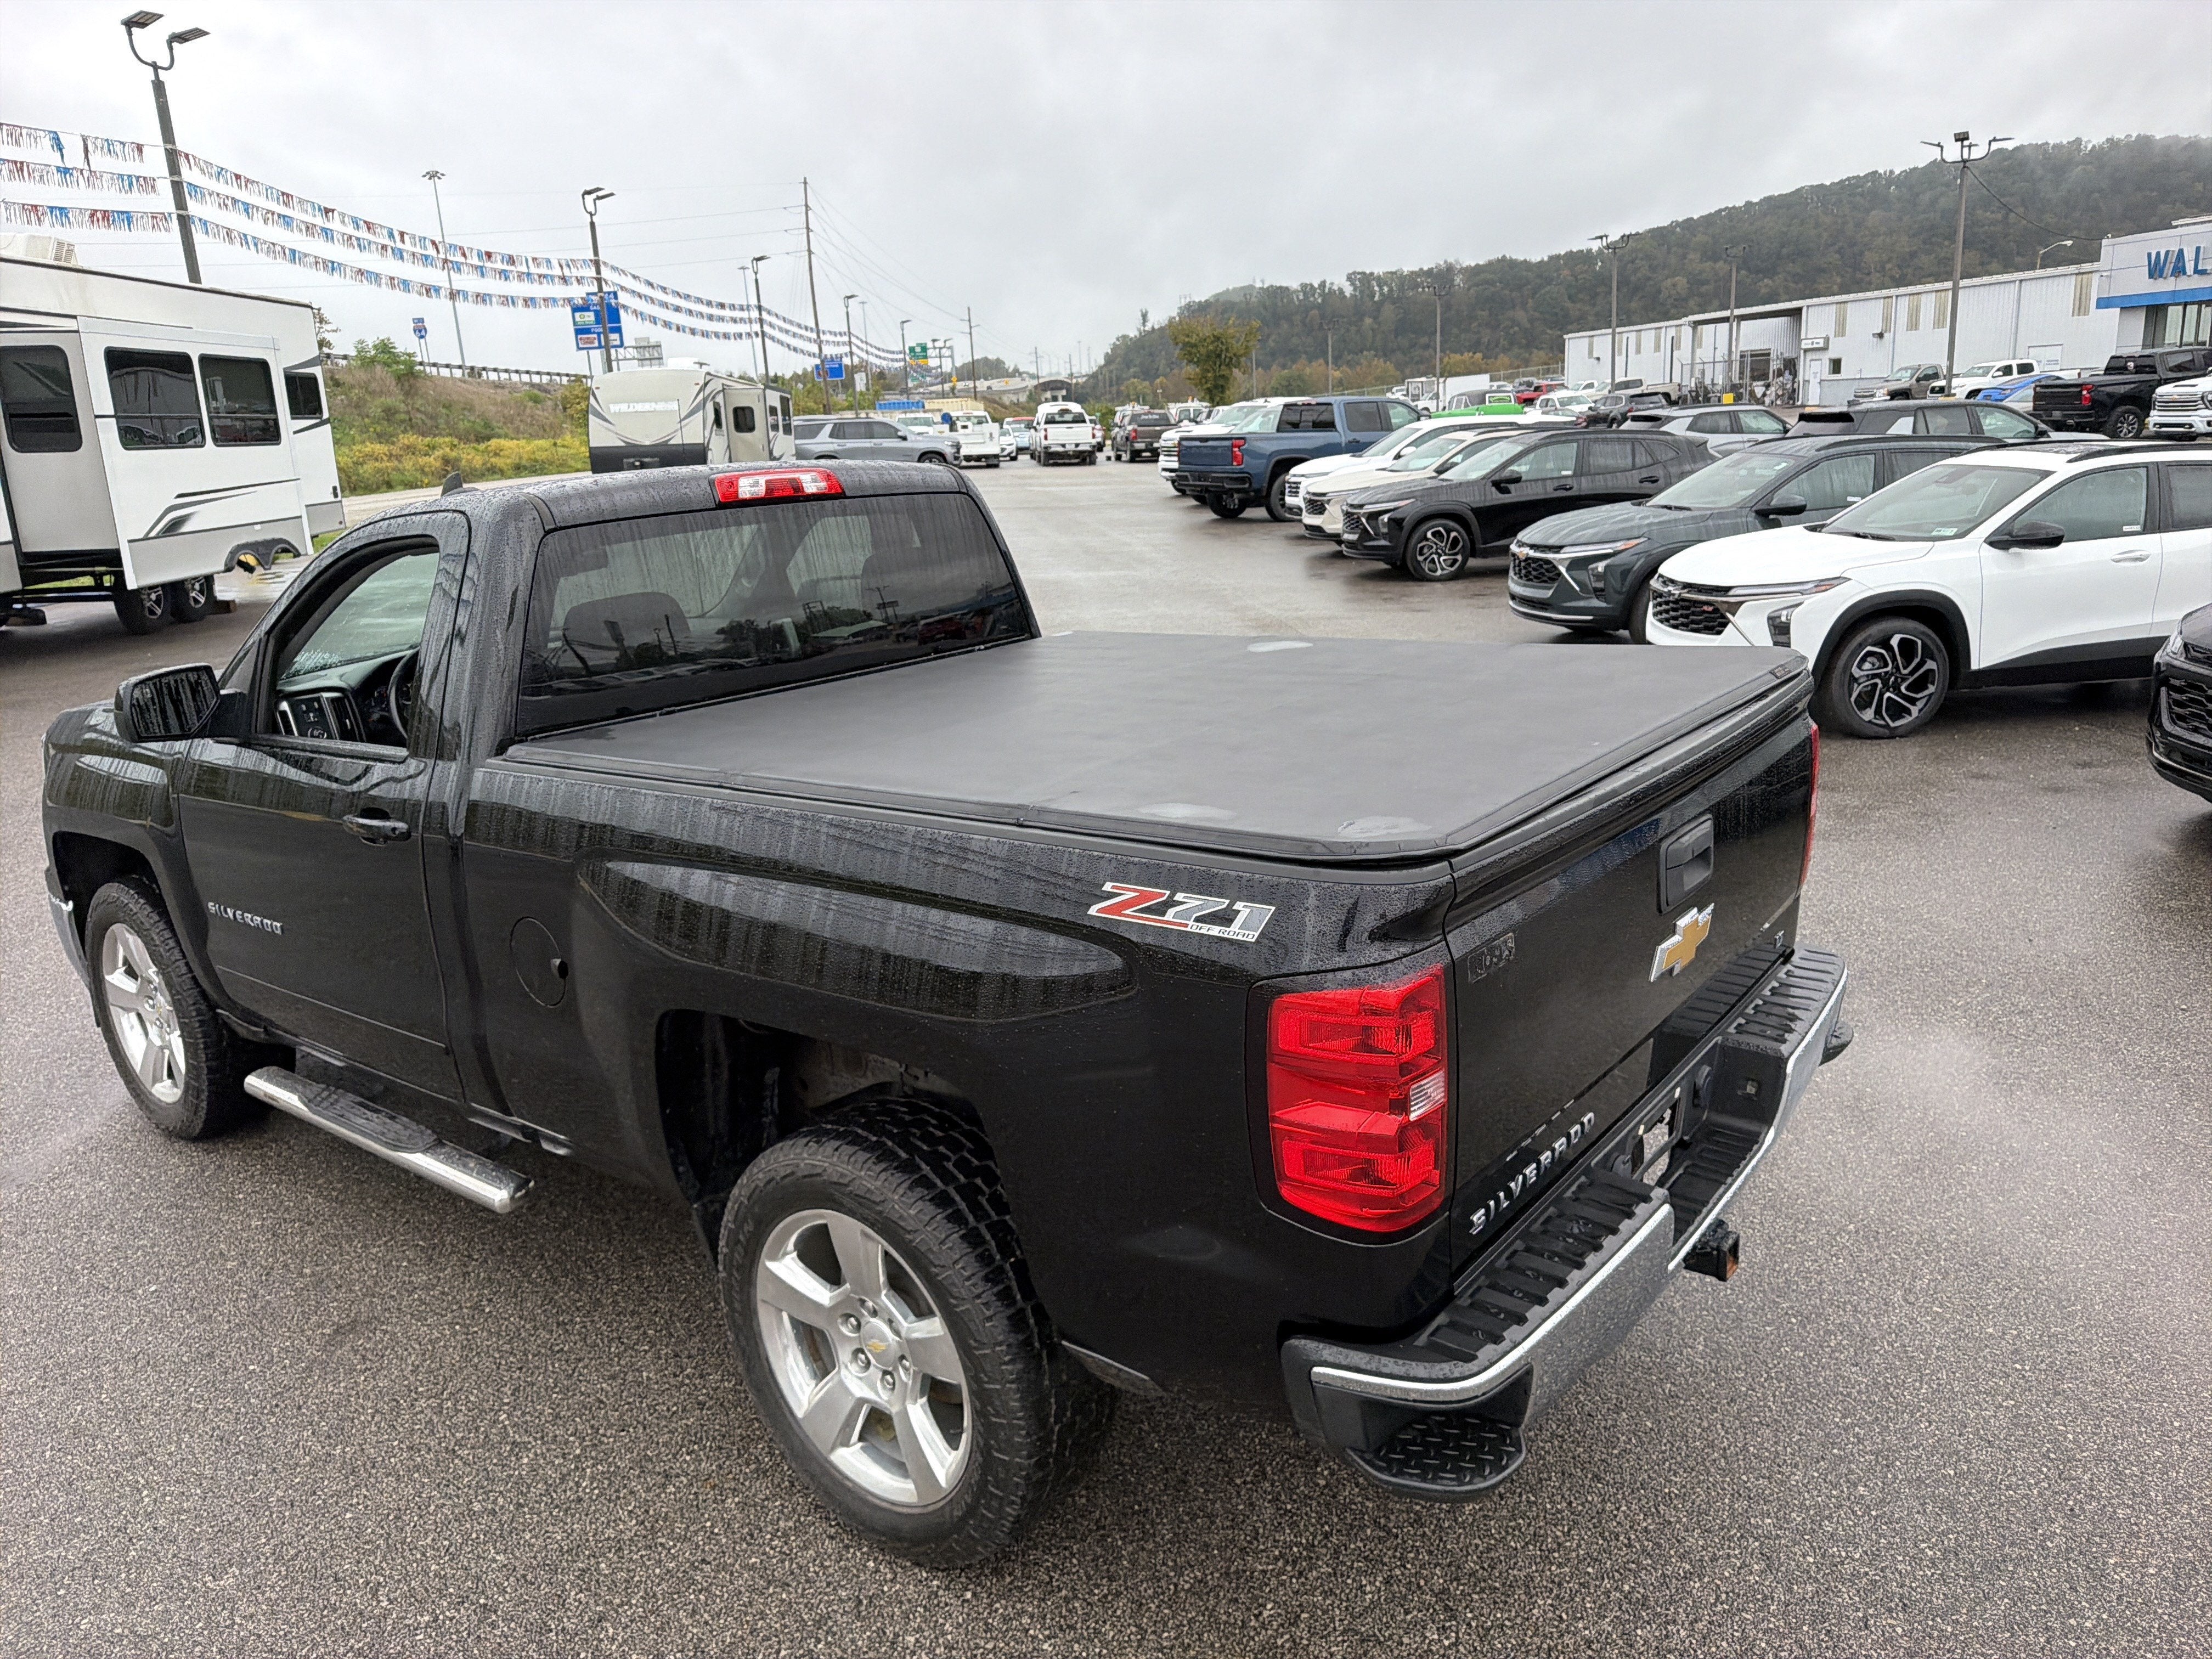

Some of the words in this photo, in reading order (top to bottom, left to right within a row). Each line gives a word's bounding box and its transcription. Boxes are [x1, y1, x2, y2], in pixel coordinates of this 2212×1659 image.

[208, 901, 283, 935] SILVERADO
[1087, 882, 1276, 933] Z71
[1189, 923, 1217, 933] OFF
[1217, 928, 1256, 940] ROAD
[1469, 1112, 1595, 1235] SILVERADO
